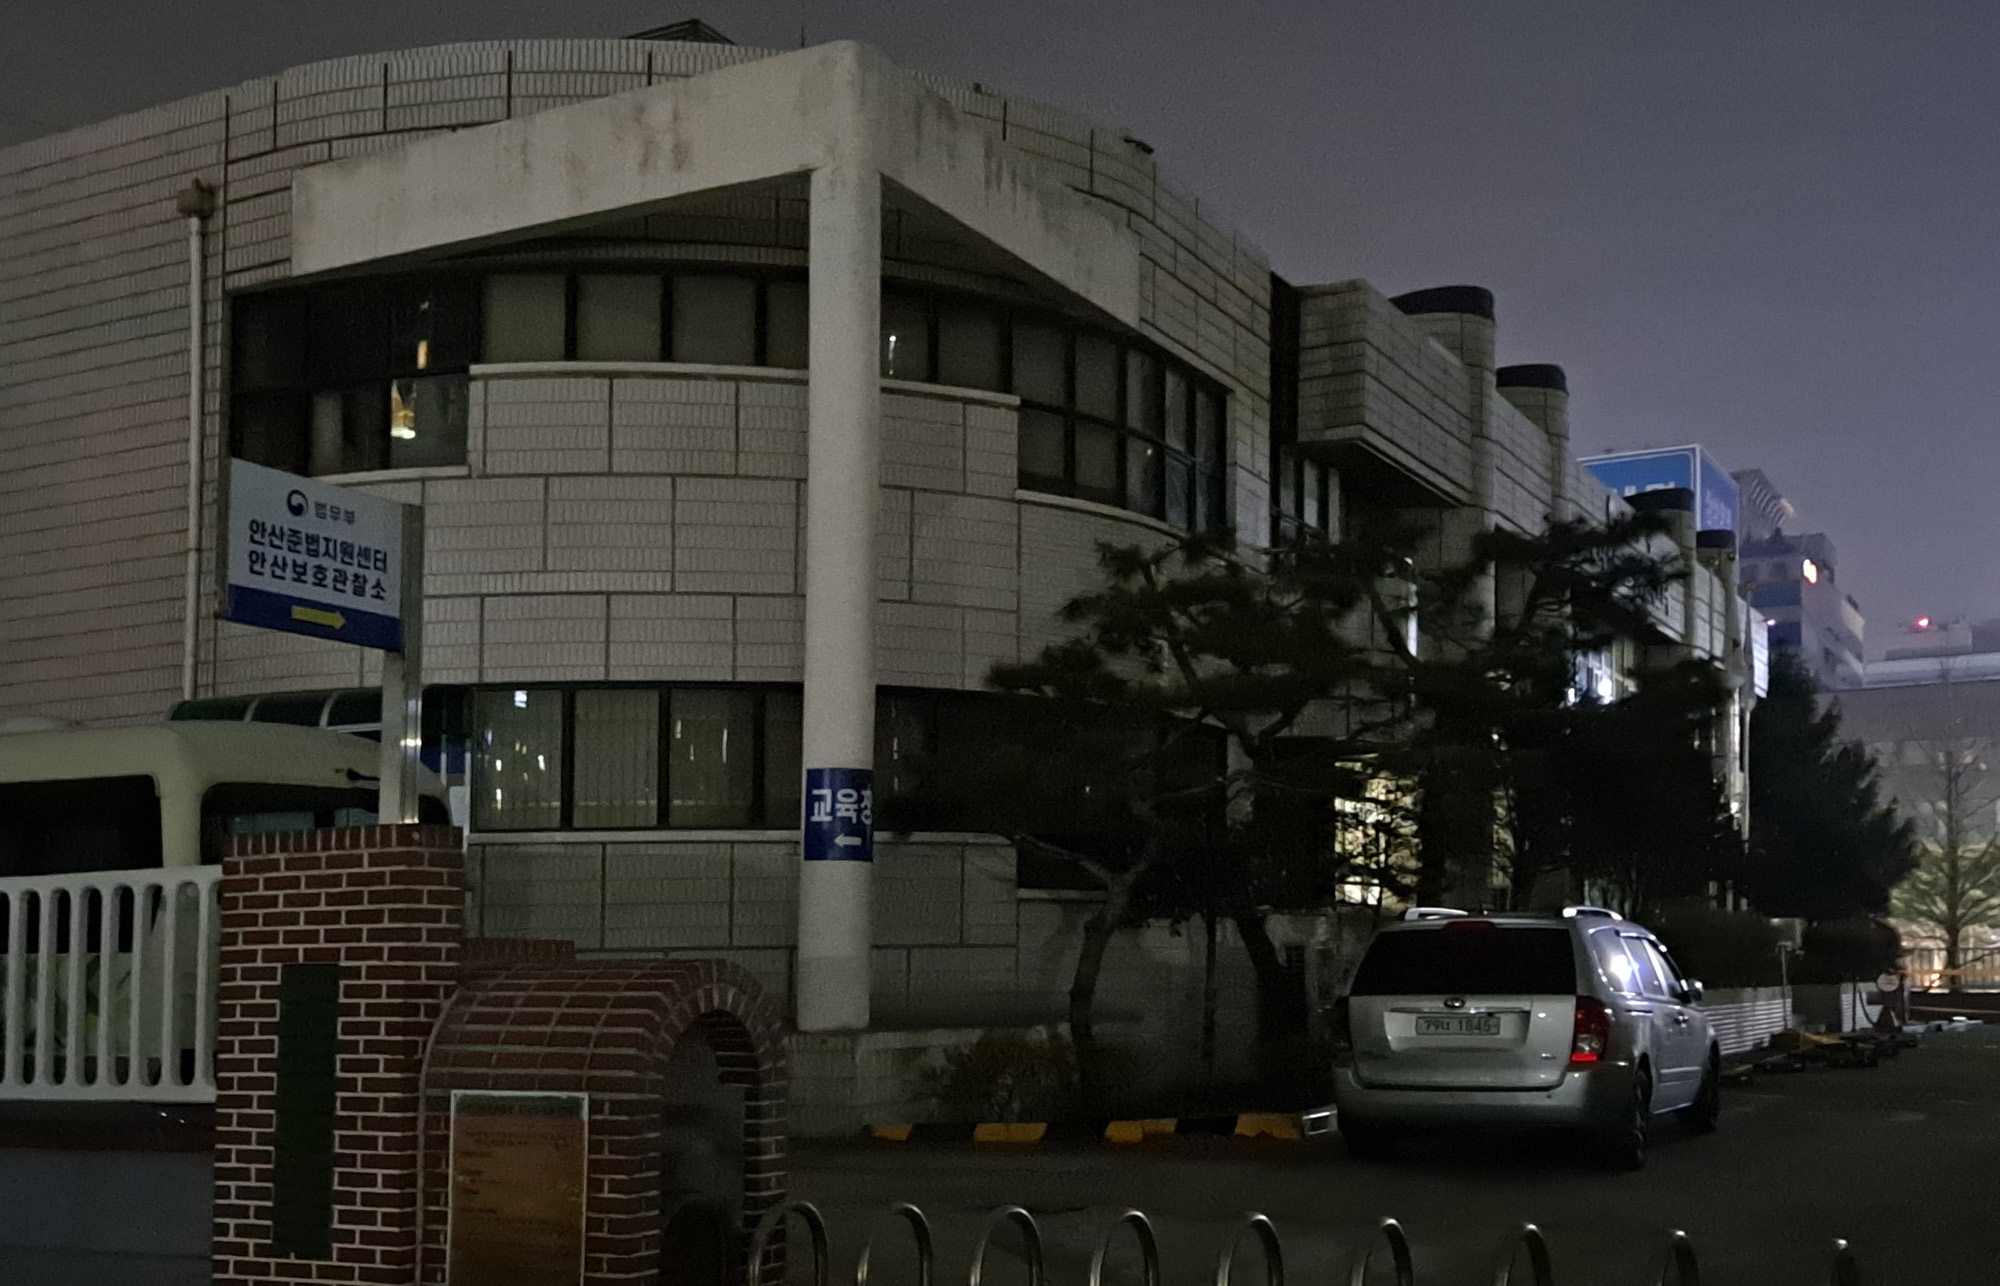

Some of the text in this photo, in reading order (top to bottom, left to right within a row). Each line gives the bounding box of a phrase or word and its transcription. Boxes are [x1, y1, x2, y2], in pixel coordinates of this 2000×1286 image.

[314, 501, 356, 525] 법무부
[249, 518, 388, 574] 안산준법지원센터
[248, 550, 387, 600] 안산보호관찰소
